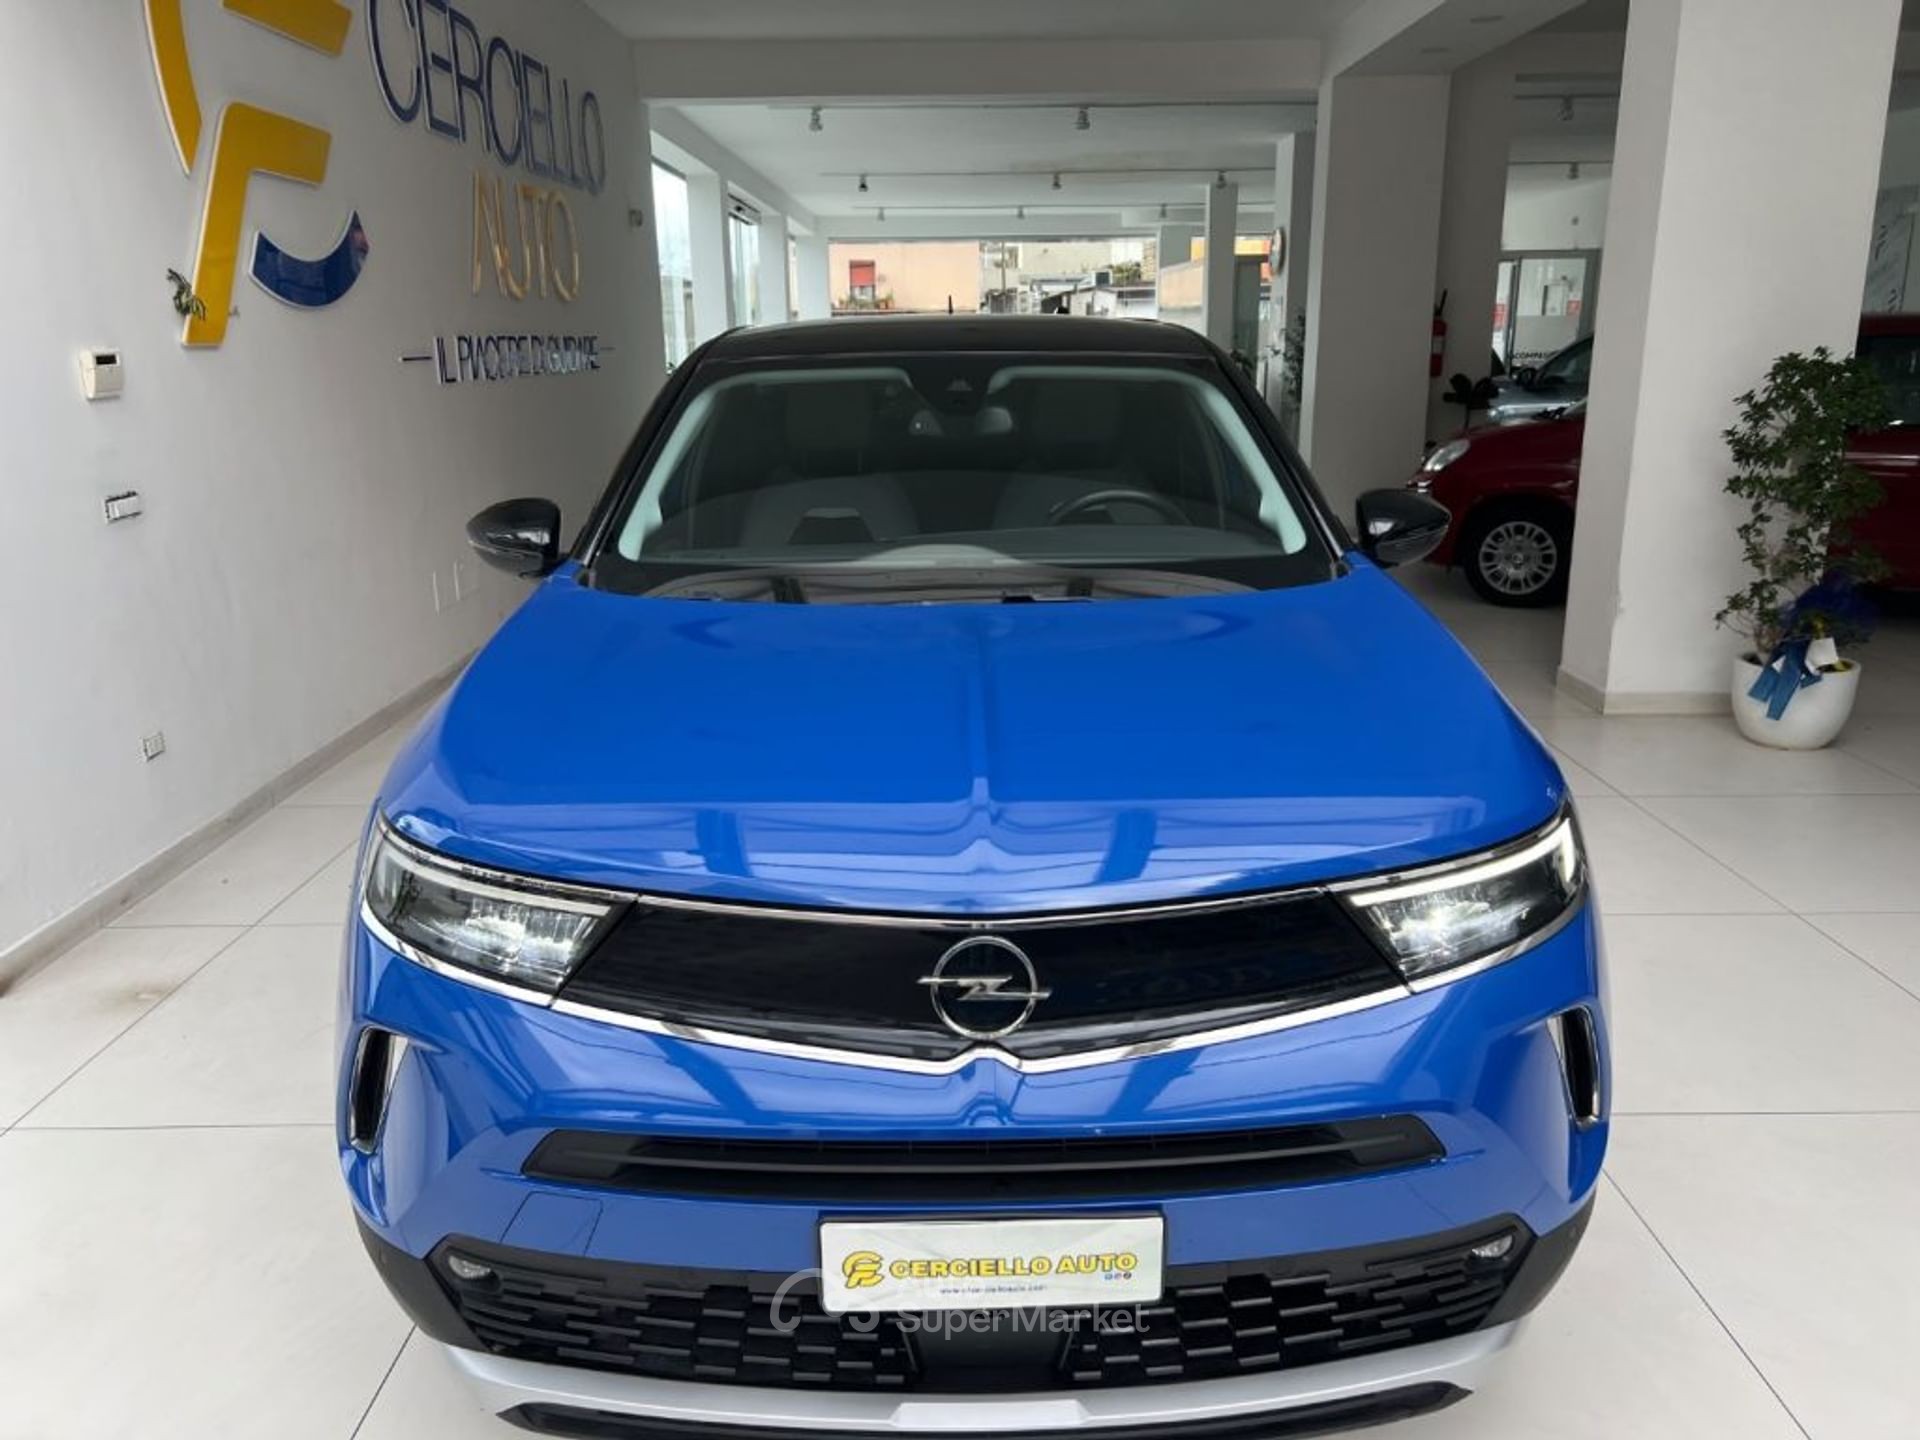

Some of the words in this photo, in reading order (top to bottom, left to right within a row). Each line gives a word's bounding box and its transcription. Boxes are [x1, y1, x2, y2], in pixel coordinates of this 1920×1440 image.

[367, 0, 605, 196] CERCIELLO
[472, 168, 580, 302] AUTO
[434, 335, 456, 384] IL
[889, 1256, 1052, 1279] CERCIELLO
[1056, 1251, 1138, 1274] AUTO
